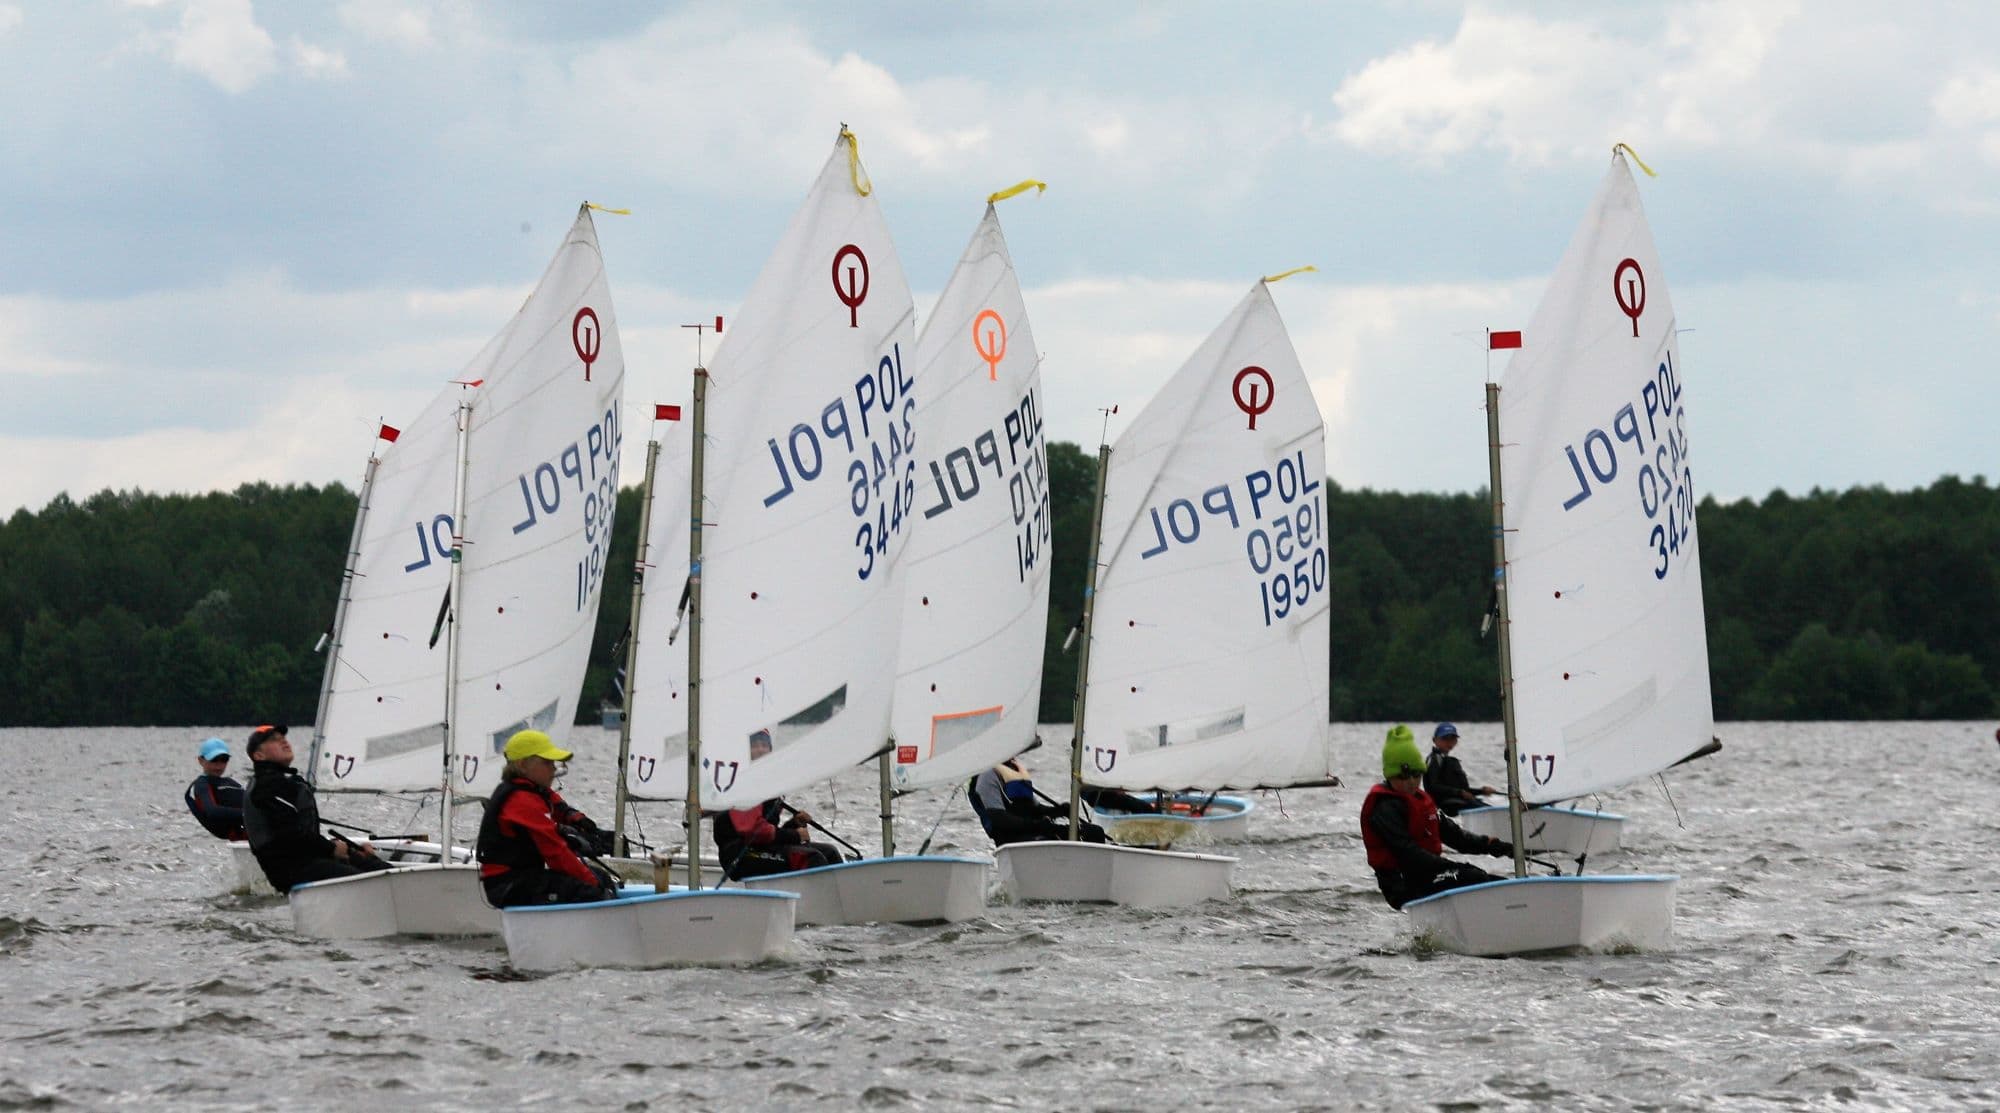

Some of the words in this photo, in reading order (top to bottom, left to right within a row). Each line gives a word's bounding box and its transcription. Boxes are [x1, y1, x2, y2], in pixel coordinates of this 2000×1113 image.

[855, 342, 914, 438] POL
[1004, 387, 1043, 466] POL
[1642, 350, 1681, 441] POL
[587, 399, 622, 481] POL
[1245, 450, 1320, 520] POL
[855, 459, 915, 580] 3446
[1017, 491, 1049, 584] 1470
[1650, 466, 1693, 580] 3420
[1260, 547, 1326, 626] 1950
